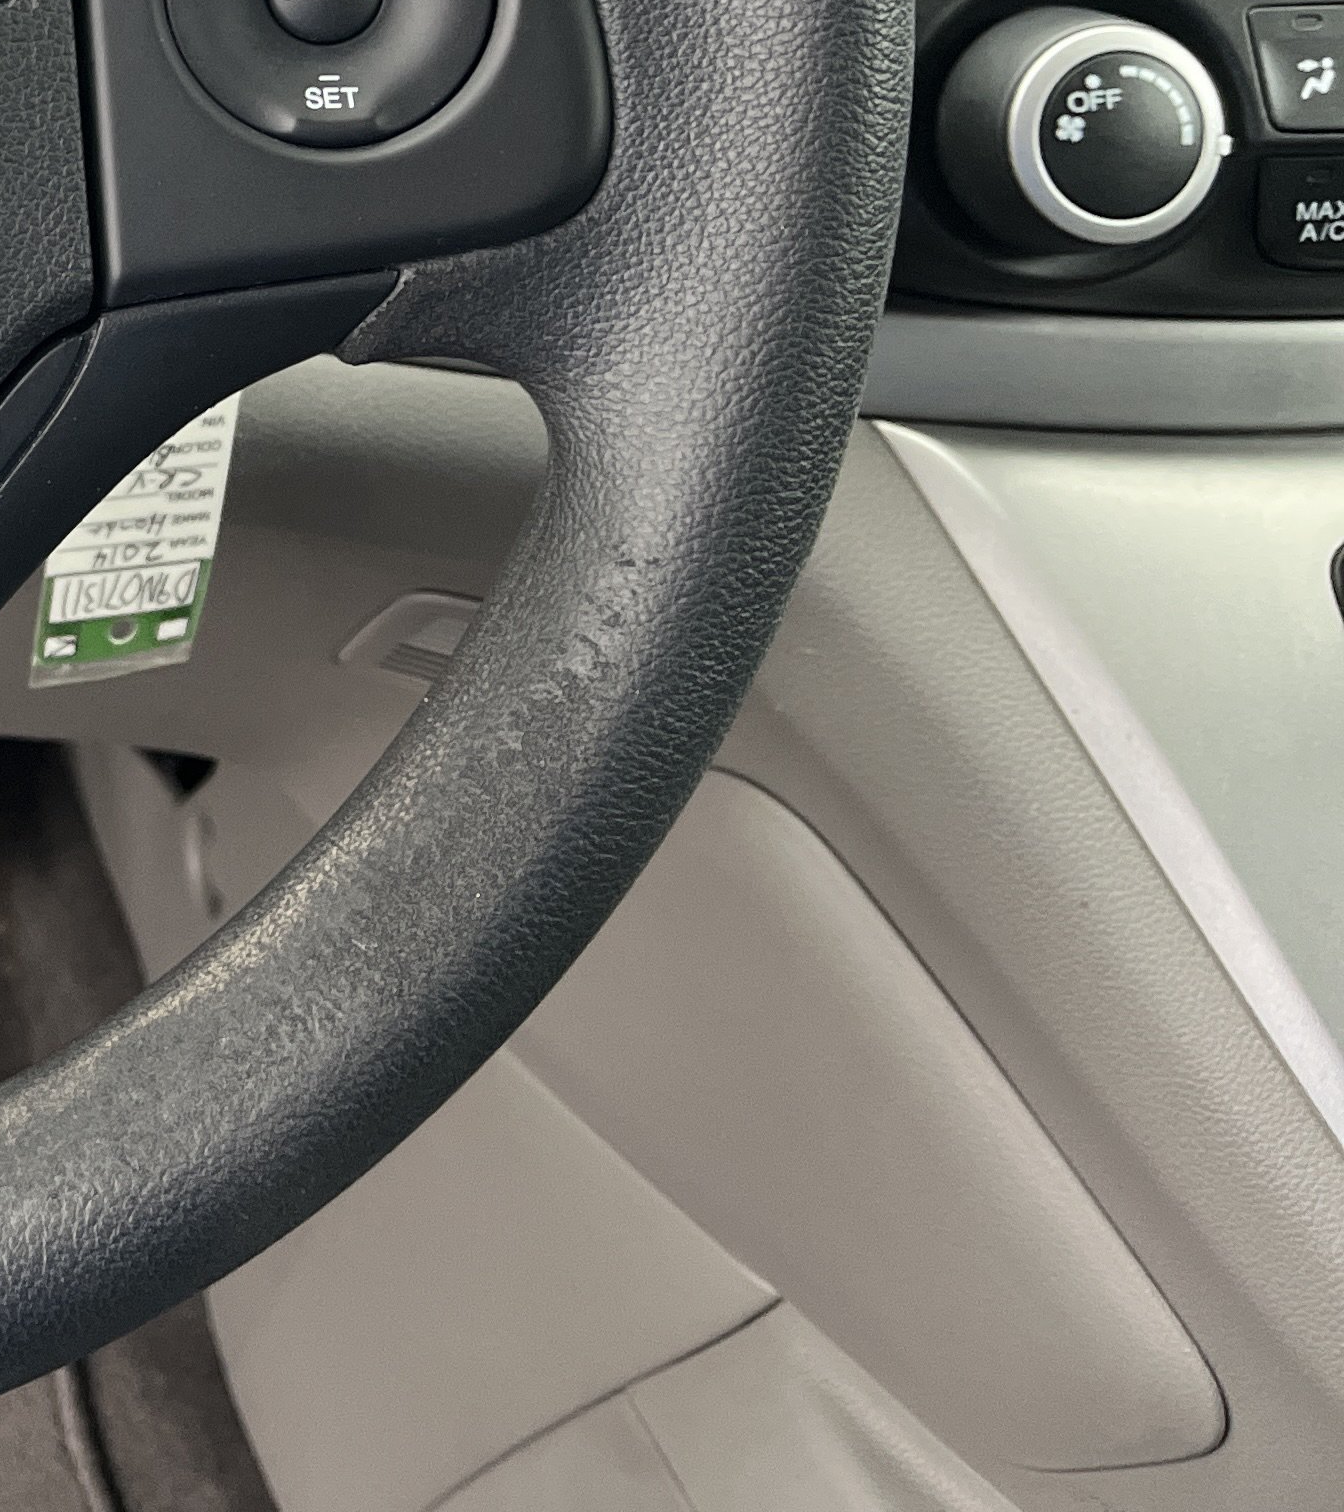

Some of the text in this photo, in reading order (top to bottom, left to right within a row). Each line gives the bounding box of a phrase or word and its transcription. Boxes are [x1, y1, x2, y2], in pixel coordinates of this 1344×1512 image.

[305, 86, 358, 109] SET
[1067, 88, 1123, 113] OFF
[1299, 221, 1344, 242] A/C
[92, 541, 163, 570] 2014
